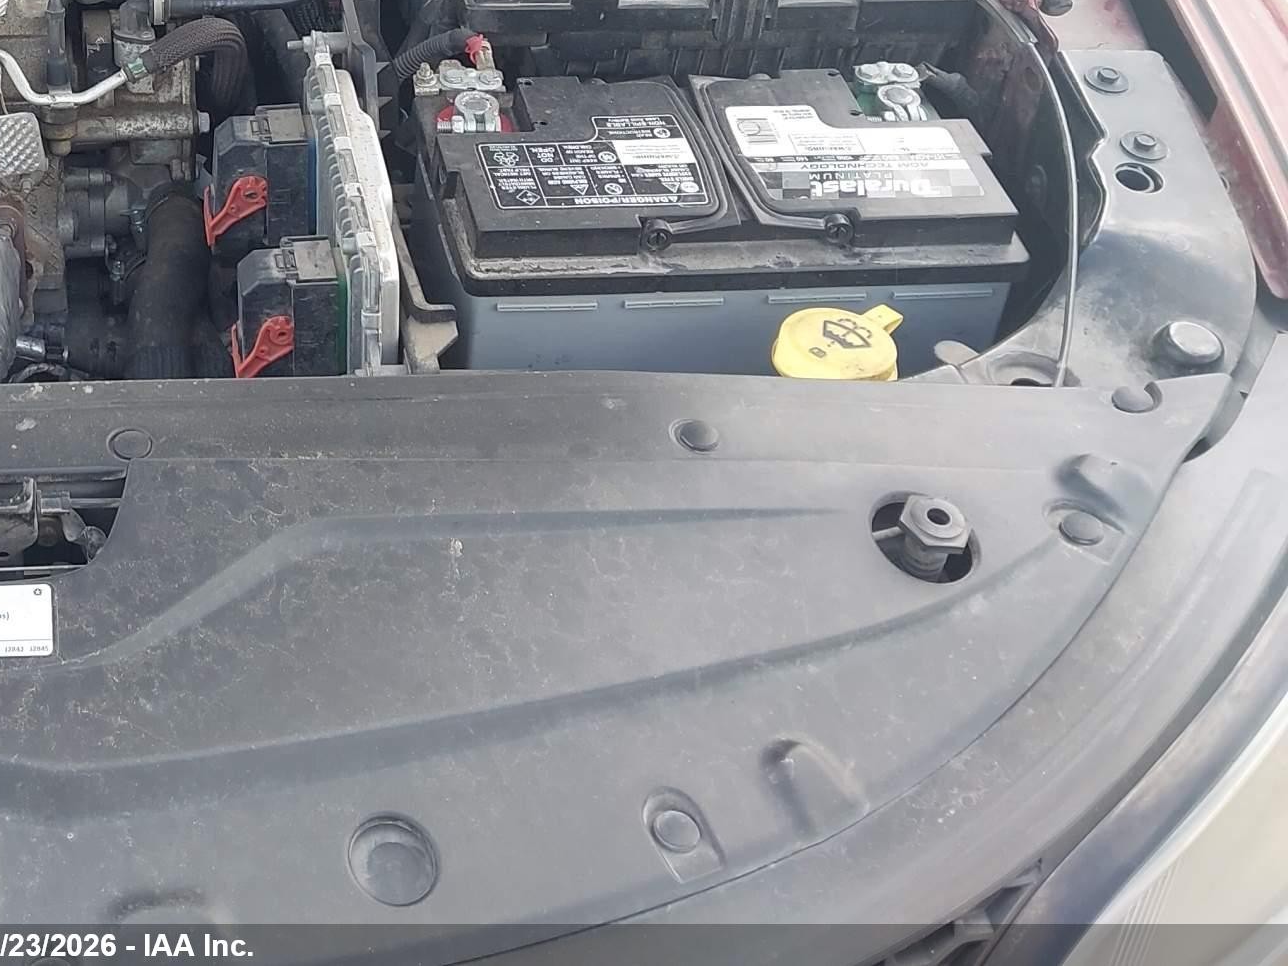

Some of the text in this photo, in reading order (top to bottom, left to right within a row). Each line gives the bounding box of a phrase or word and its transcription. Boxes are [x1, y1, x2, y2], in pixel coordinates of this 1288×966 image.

[800, 163, 892, 171] TECHNOLOGY
[808, 172, 893, 180] PLATINUM
[810, 179, 941, 198] Duralast
